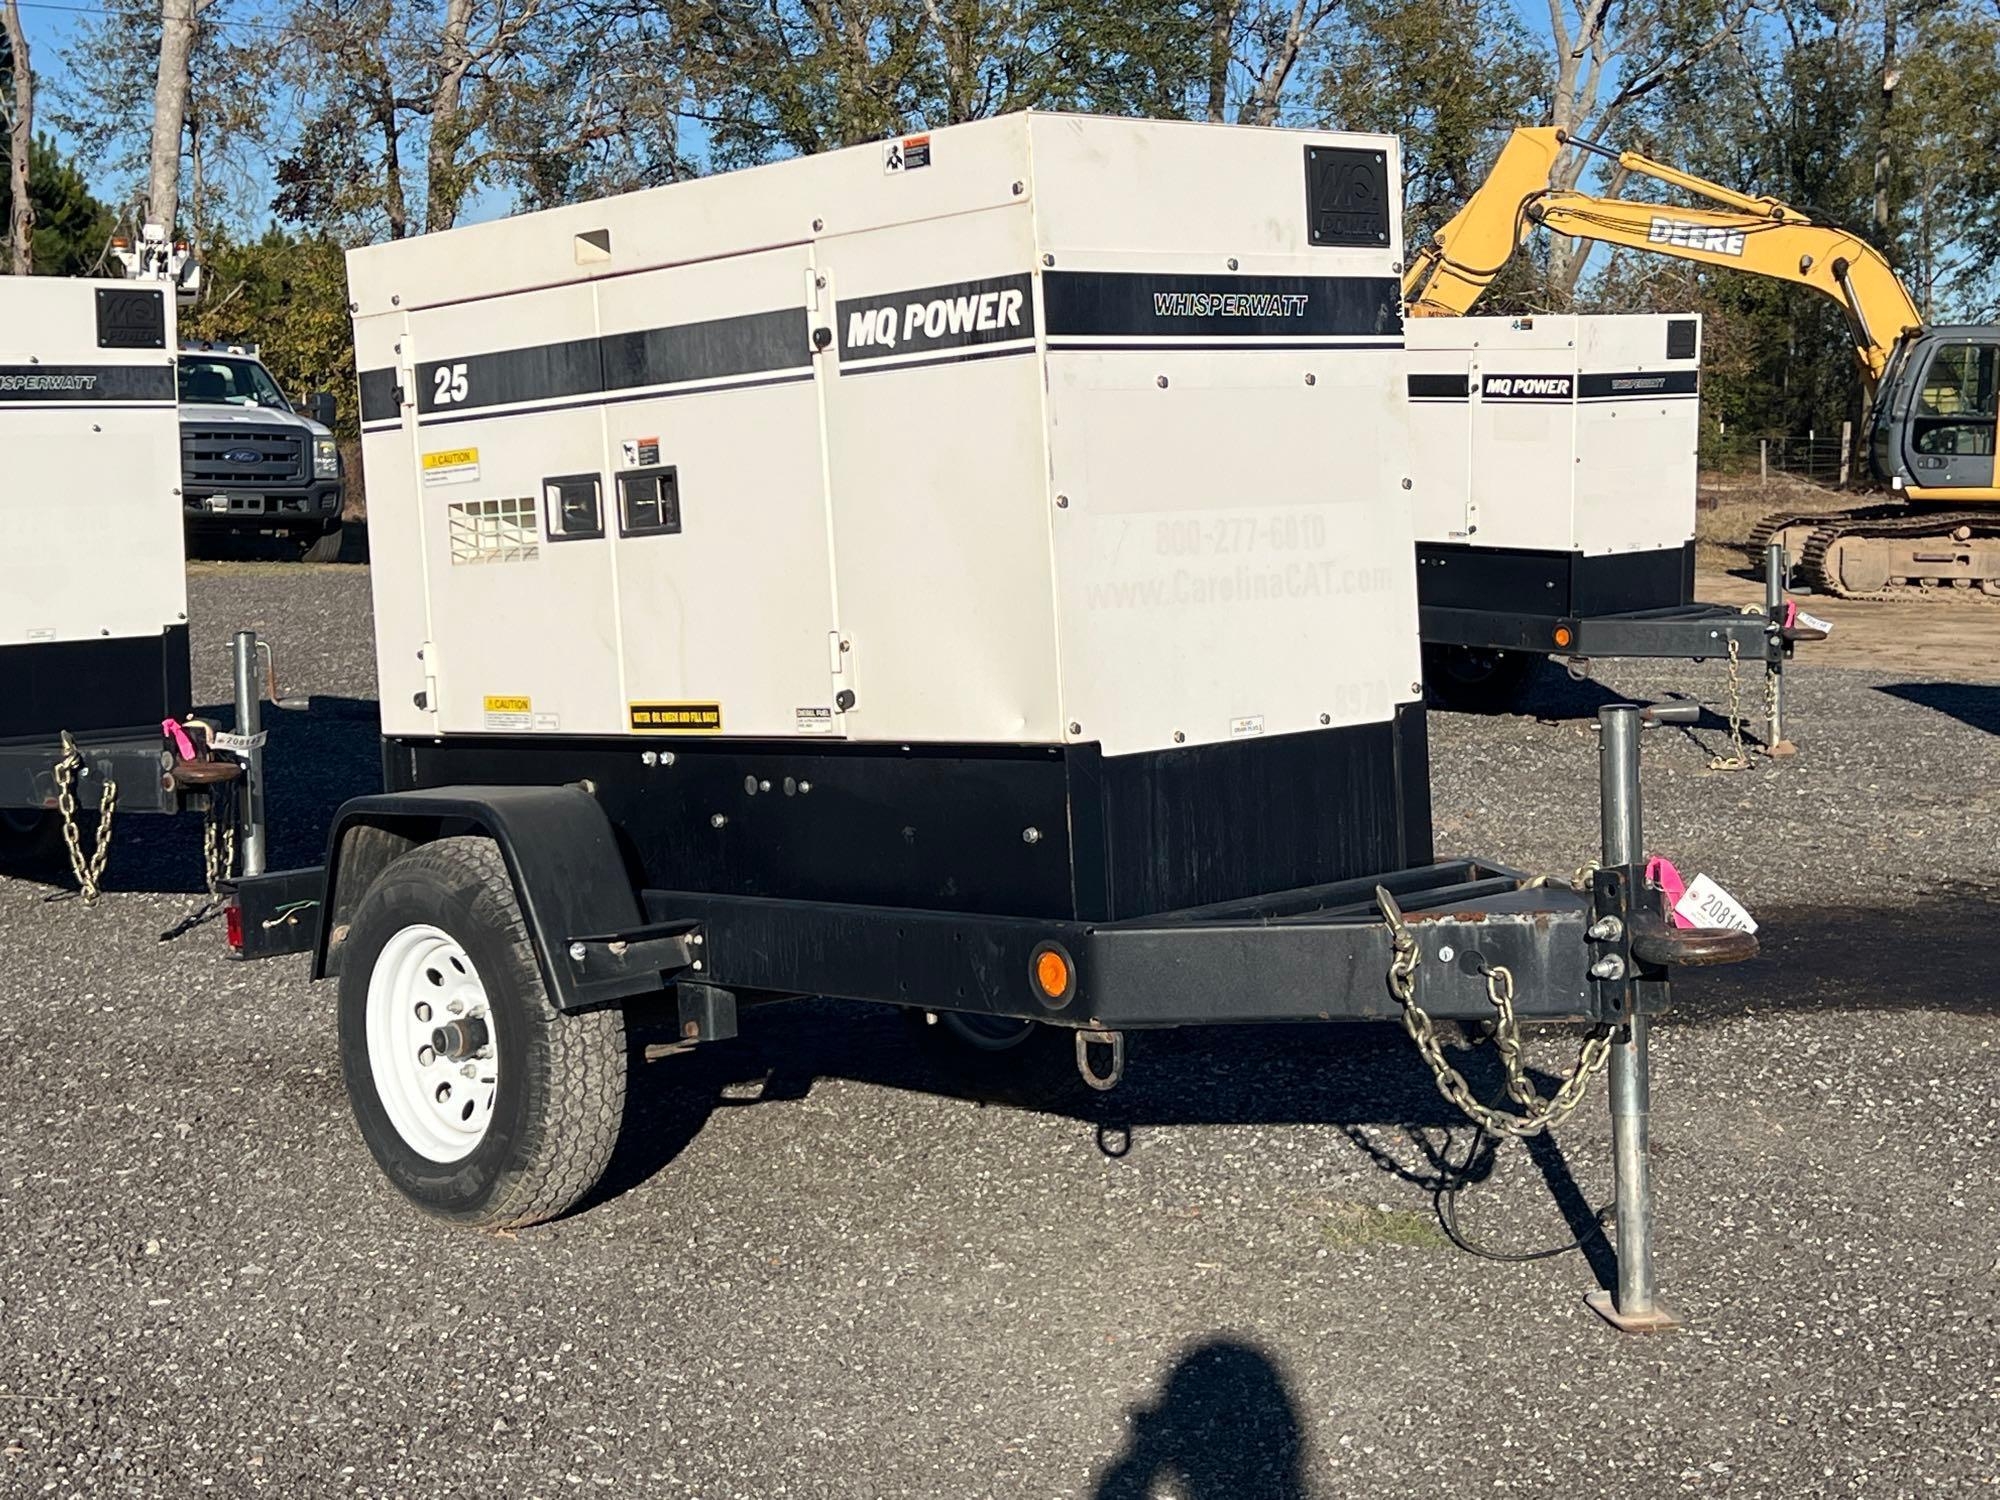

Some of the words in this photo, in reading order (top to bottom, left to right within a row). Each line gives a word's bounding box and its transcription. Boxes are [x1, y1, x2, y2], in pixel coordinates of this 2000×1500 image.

[1648, 216, 1746, 256] DEERE
[847, 306, 898, 350] MQ
[902, 289, 1023, 341] POWER
[1153, 292, 1308, 317] WHISPERWATT
[434, 363, 469, 405] 25
[1486, 379, 1511, 396] MQ
[1513, 379, 1570, 395] POWER
[438, 452, 471, 465] CAUTION
[1155, 514, 1326, 556] 800-277-6010
[1085, 561, 1393, 611] www.CarolinaCAT.com
[494, 699, 529, 709] CAUTION
